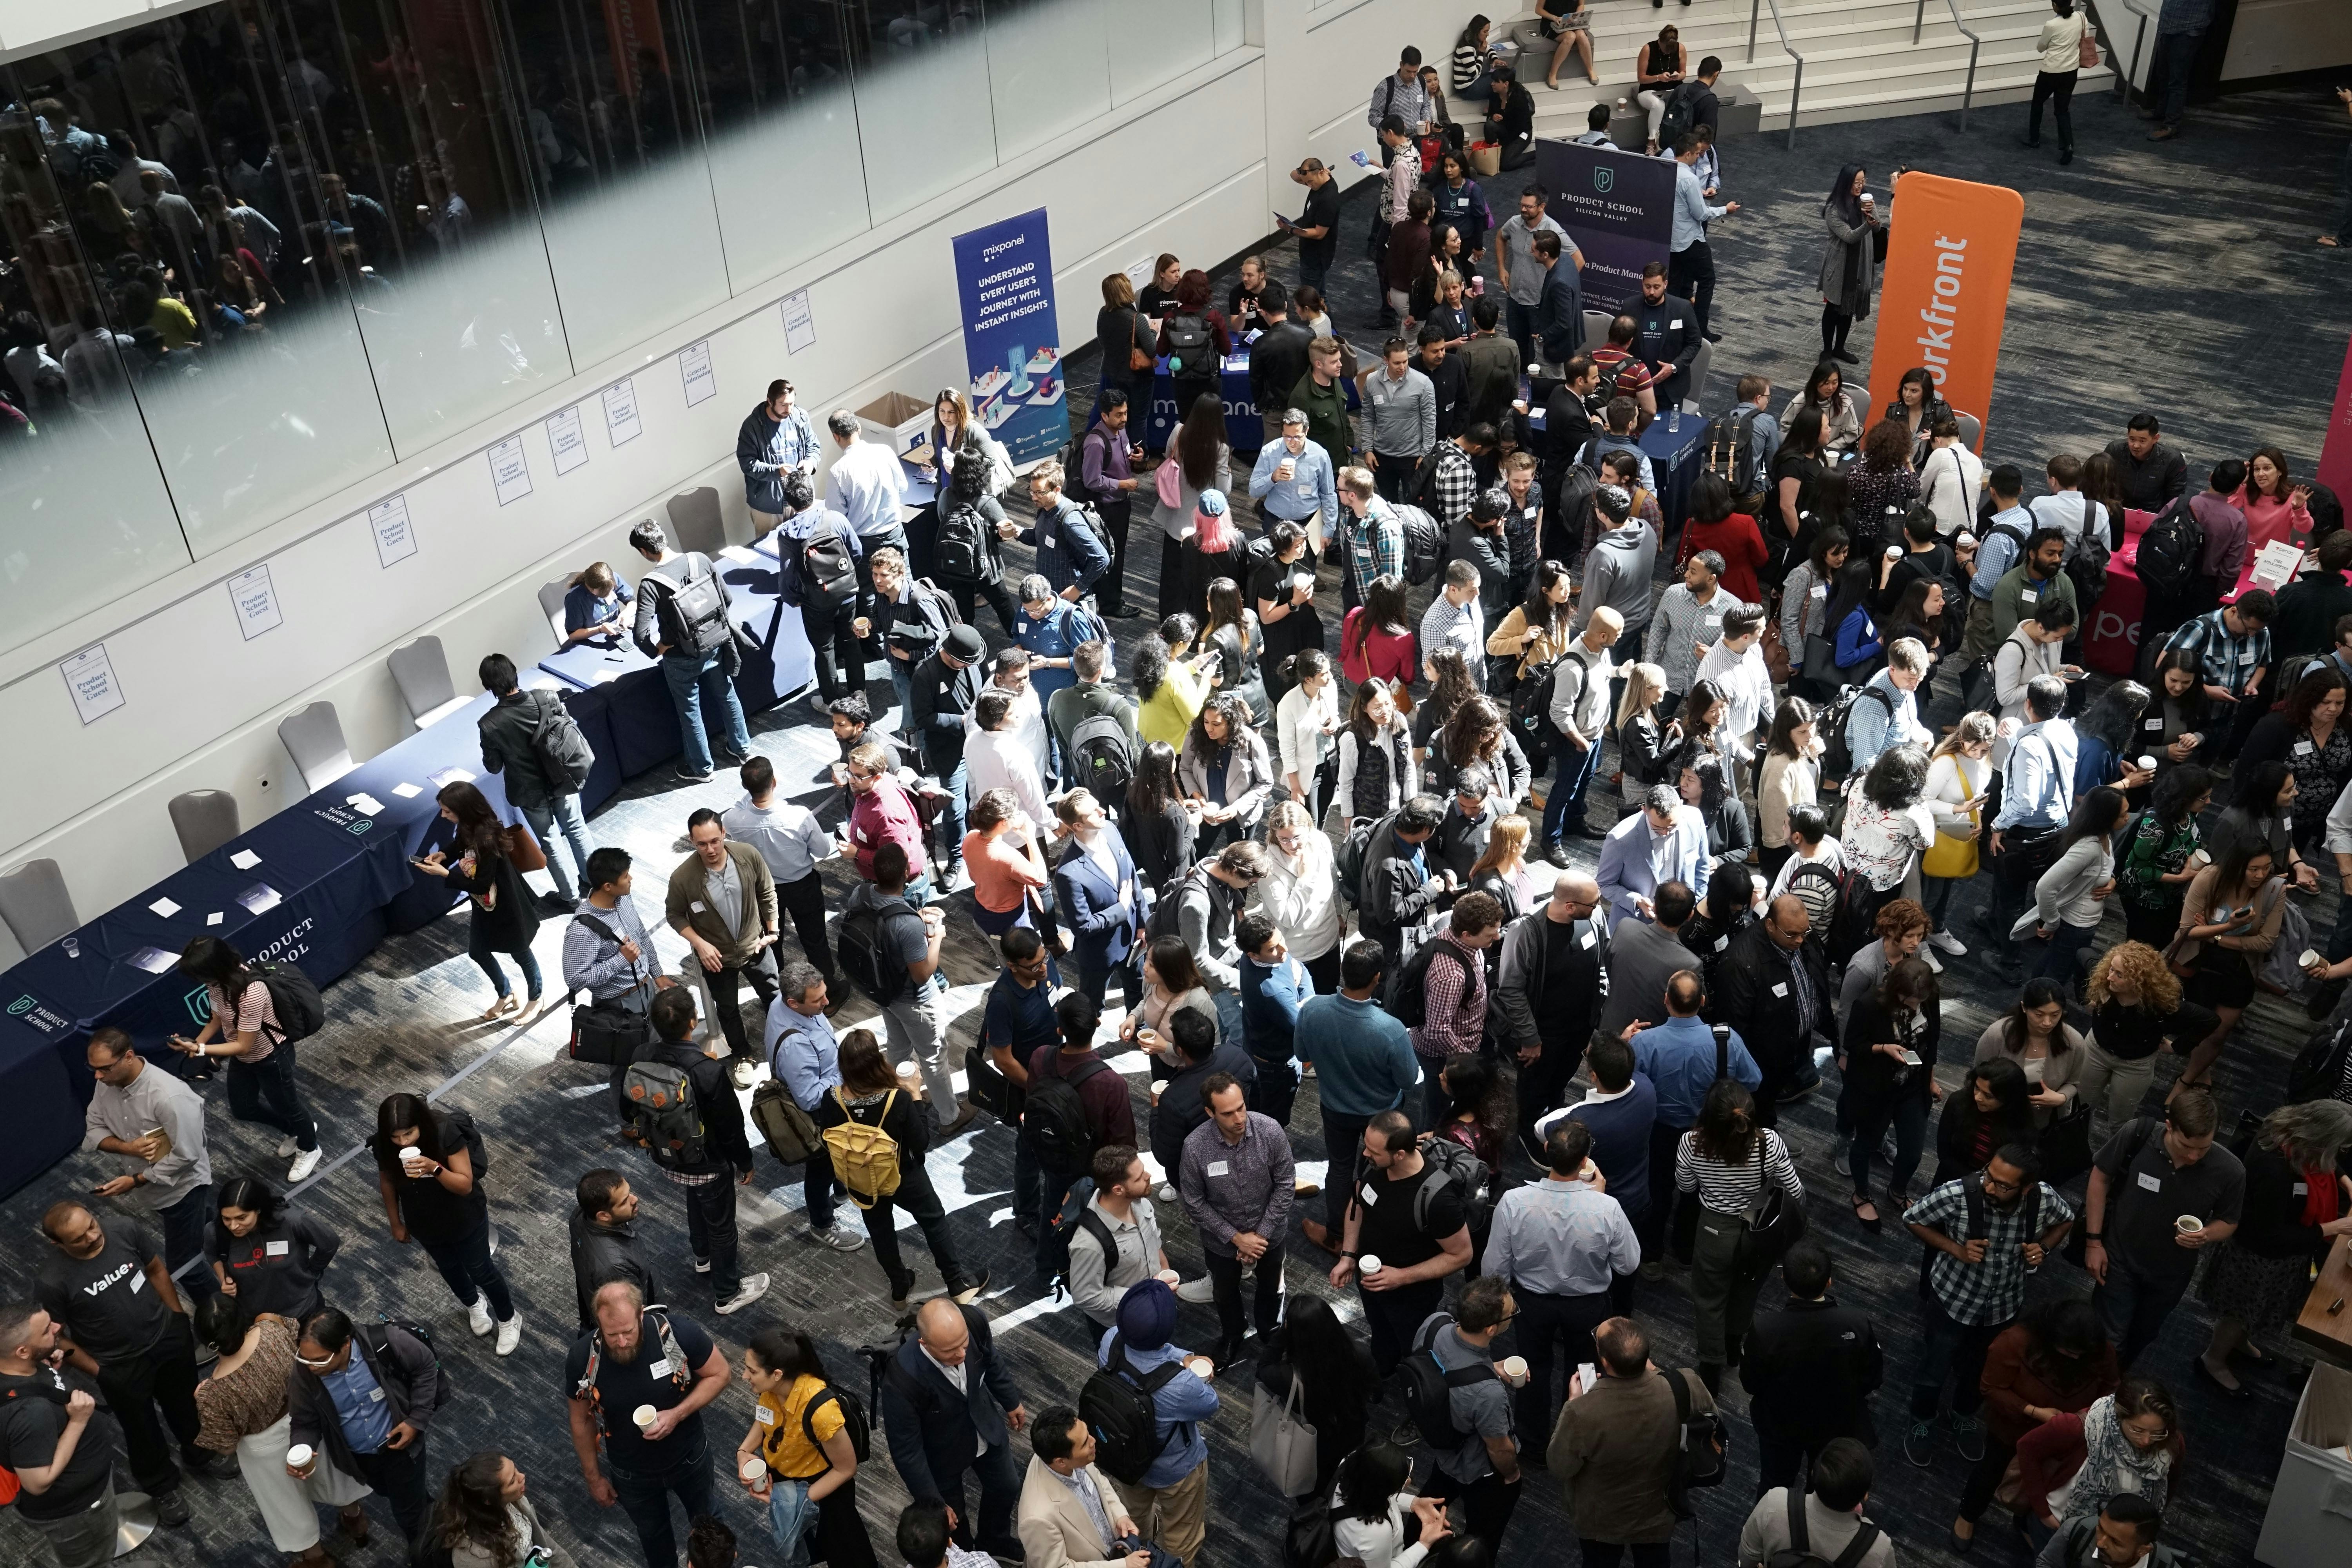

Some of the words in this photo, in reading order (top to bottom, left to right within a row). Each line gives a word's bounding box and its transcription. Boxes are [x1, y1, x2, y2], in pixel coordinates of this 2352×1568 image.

[1562, 193, 1603, 207] PRODUCT
[1607, 202, 1644, 215] SCHOOL
[1576, 207, 1601, 216] SILICON
[1604, 213, 1628, 221] VALLEY
[983, 234, 1024, 256] mixpanel
[979, 262, 1034, 288] UNDERSTAND
[1591, 262, 1619, 275] Product
[1621, 269, 1643, 280] Mana
[980, 285, 1006, 301] EVERY
[1008, 276, 1036, 291] USER'S
[979, 297, 1018, 316] JOURNEY
[1019, 289, 1040, 301] WITH
[1601, 302, 1622, 310] campuse
[1602, 296, 1620, 305] Coding,
[788, 313, 806, 325] General
[975, 312, 1009, 332] INSTANT
[1011, 300, 1047, 319] INSIGHTS
[1917, 235, 1967, 401] orkfront
[788, 318, 810, 333] Admission
[686, 369, 711, 385] Admission
[687, 364, 706, 377] General
[612, 404, 630, 416] Product
[615, 409, 630, 420] School
[1154, 399, 1262, 416] mane
[611, 412, 636, 428] Community
[1046, 424, 1060, 432] Microsoft
[557, 431, 575, 443] Product
[560, 437, 575, 448] School
[1021, 434, 1036, 442] Expedia
[555, 440, 582, 456] Community
[1680, 437, 1696, 454] PRODUCT
[1679, 447, 1693, 462] SCHOOL
[499, 461, 519, 474] Product
[502, 467, 519, 478] School
[497, 470, 526, 486] Community
[2279, 546, 2294, 555] pendo
[241, 590, 268, 607] Product
[245, 599, 268, 613] School
[249, 606, 269, 618] Guest
[77, 671, 107, 690] Product
[82, 680, 107, 696] School
[86, 687, 109, 701] Guest
[314, 810, 347, 825] PRODUCT
[328, 806, 355, 821] SCHOOL
[246, 917, 313, 965] RODUCT
[24, 1014, 53, 1032] SCHOOL
[34, 1007, 68, 1028] PRODUCT
[2140, 1177, 2155, 1187] ERIK
[83, 1263, 129, 1296] Value
